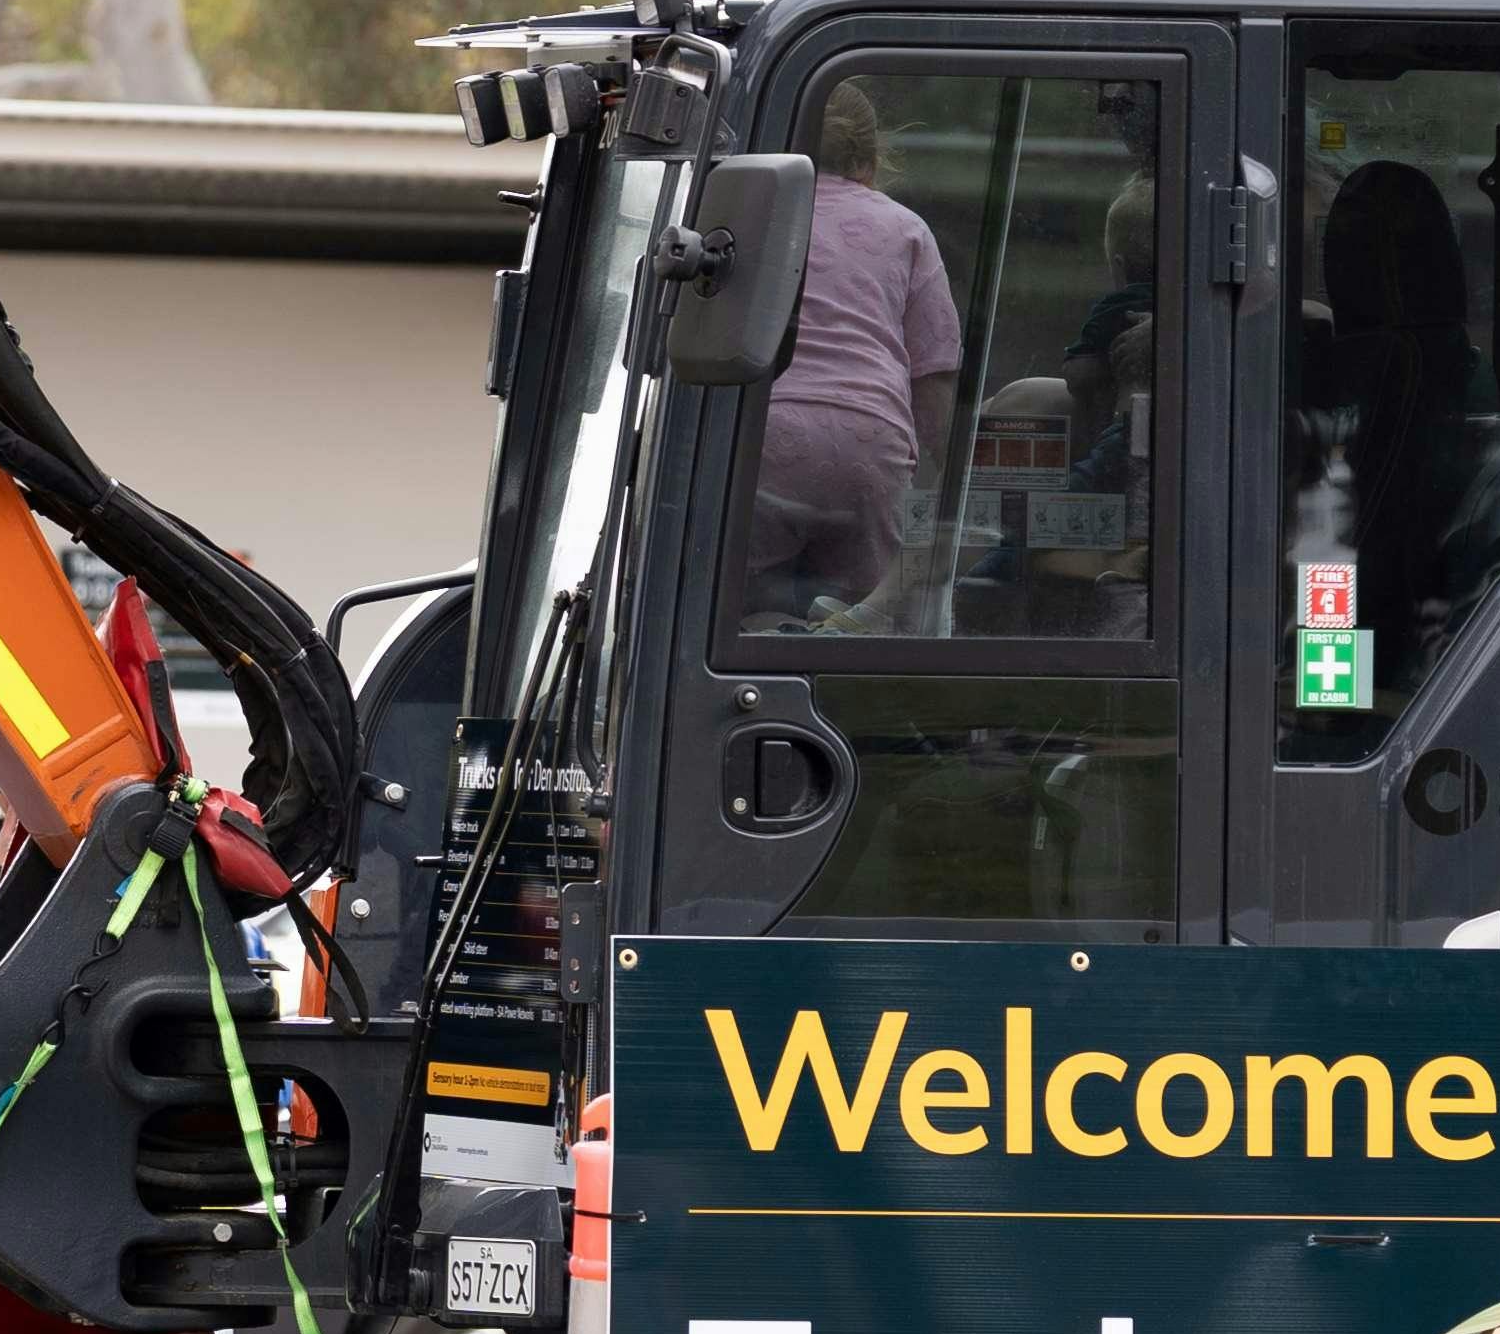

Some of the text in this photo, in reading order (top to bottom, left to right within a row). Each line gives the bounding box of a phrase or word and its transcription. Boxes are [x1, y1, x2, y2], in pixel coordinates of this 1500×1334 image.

[1315, 571, 1346, 582] FIRE
[1314, 614, 1346, 622] INSIDE
[1307, 633, 1352, 644] FIRST AID
[1308, 692, 1349, 703] IN CABIN
[458, 756, 495, 790] Trucks
[705, 1007, 1496, 1160] Welcome
[480, 1246, 493, 1260] SA
